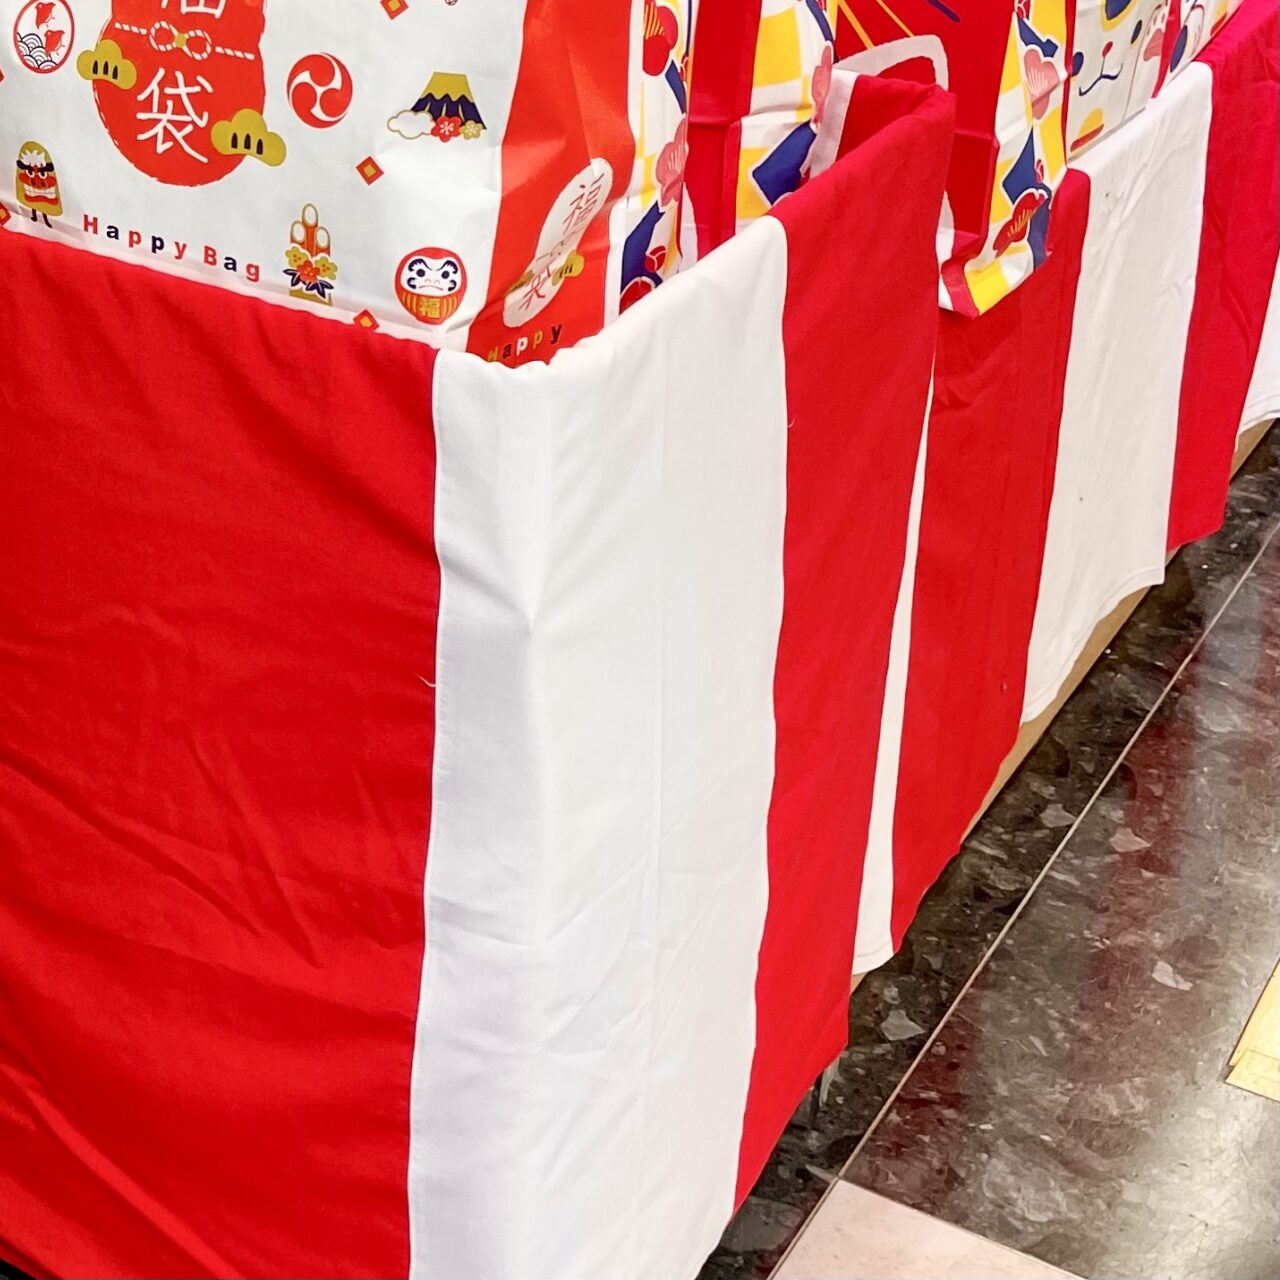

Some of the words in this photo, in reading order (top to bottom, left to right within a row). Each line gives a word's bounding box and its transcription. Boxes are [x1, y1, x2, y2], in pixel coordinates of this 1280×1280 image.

[83, 214, 187, 260] Happy
[203, 245, 260, 283] Bag
[487, 323, 562, 362] Happy
